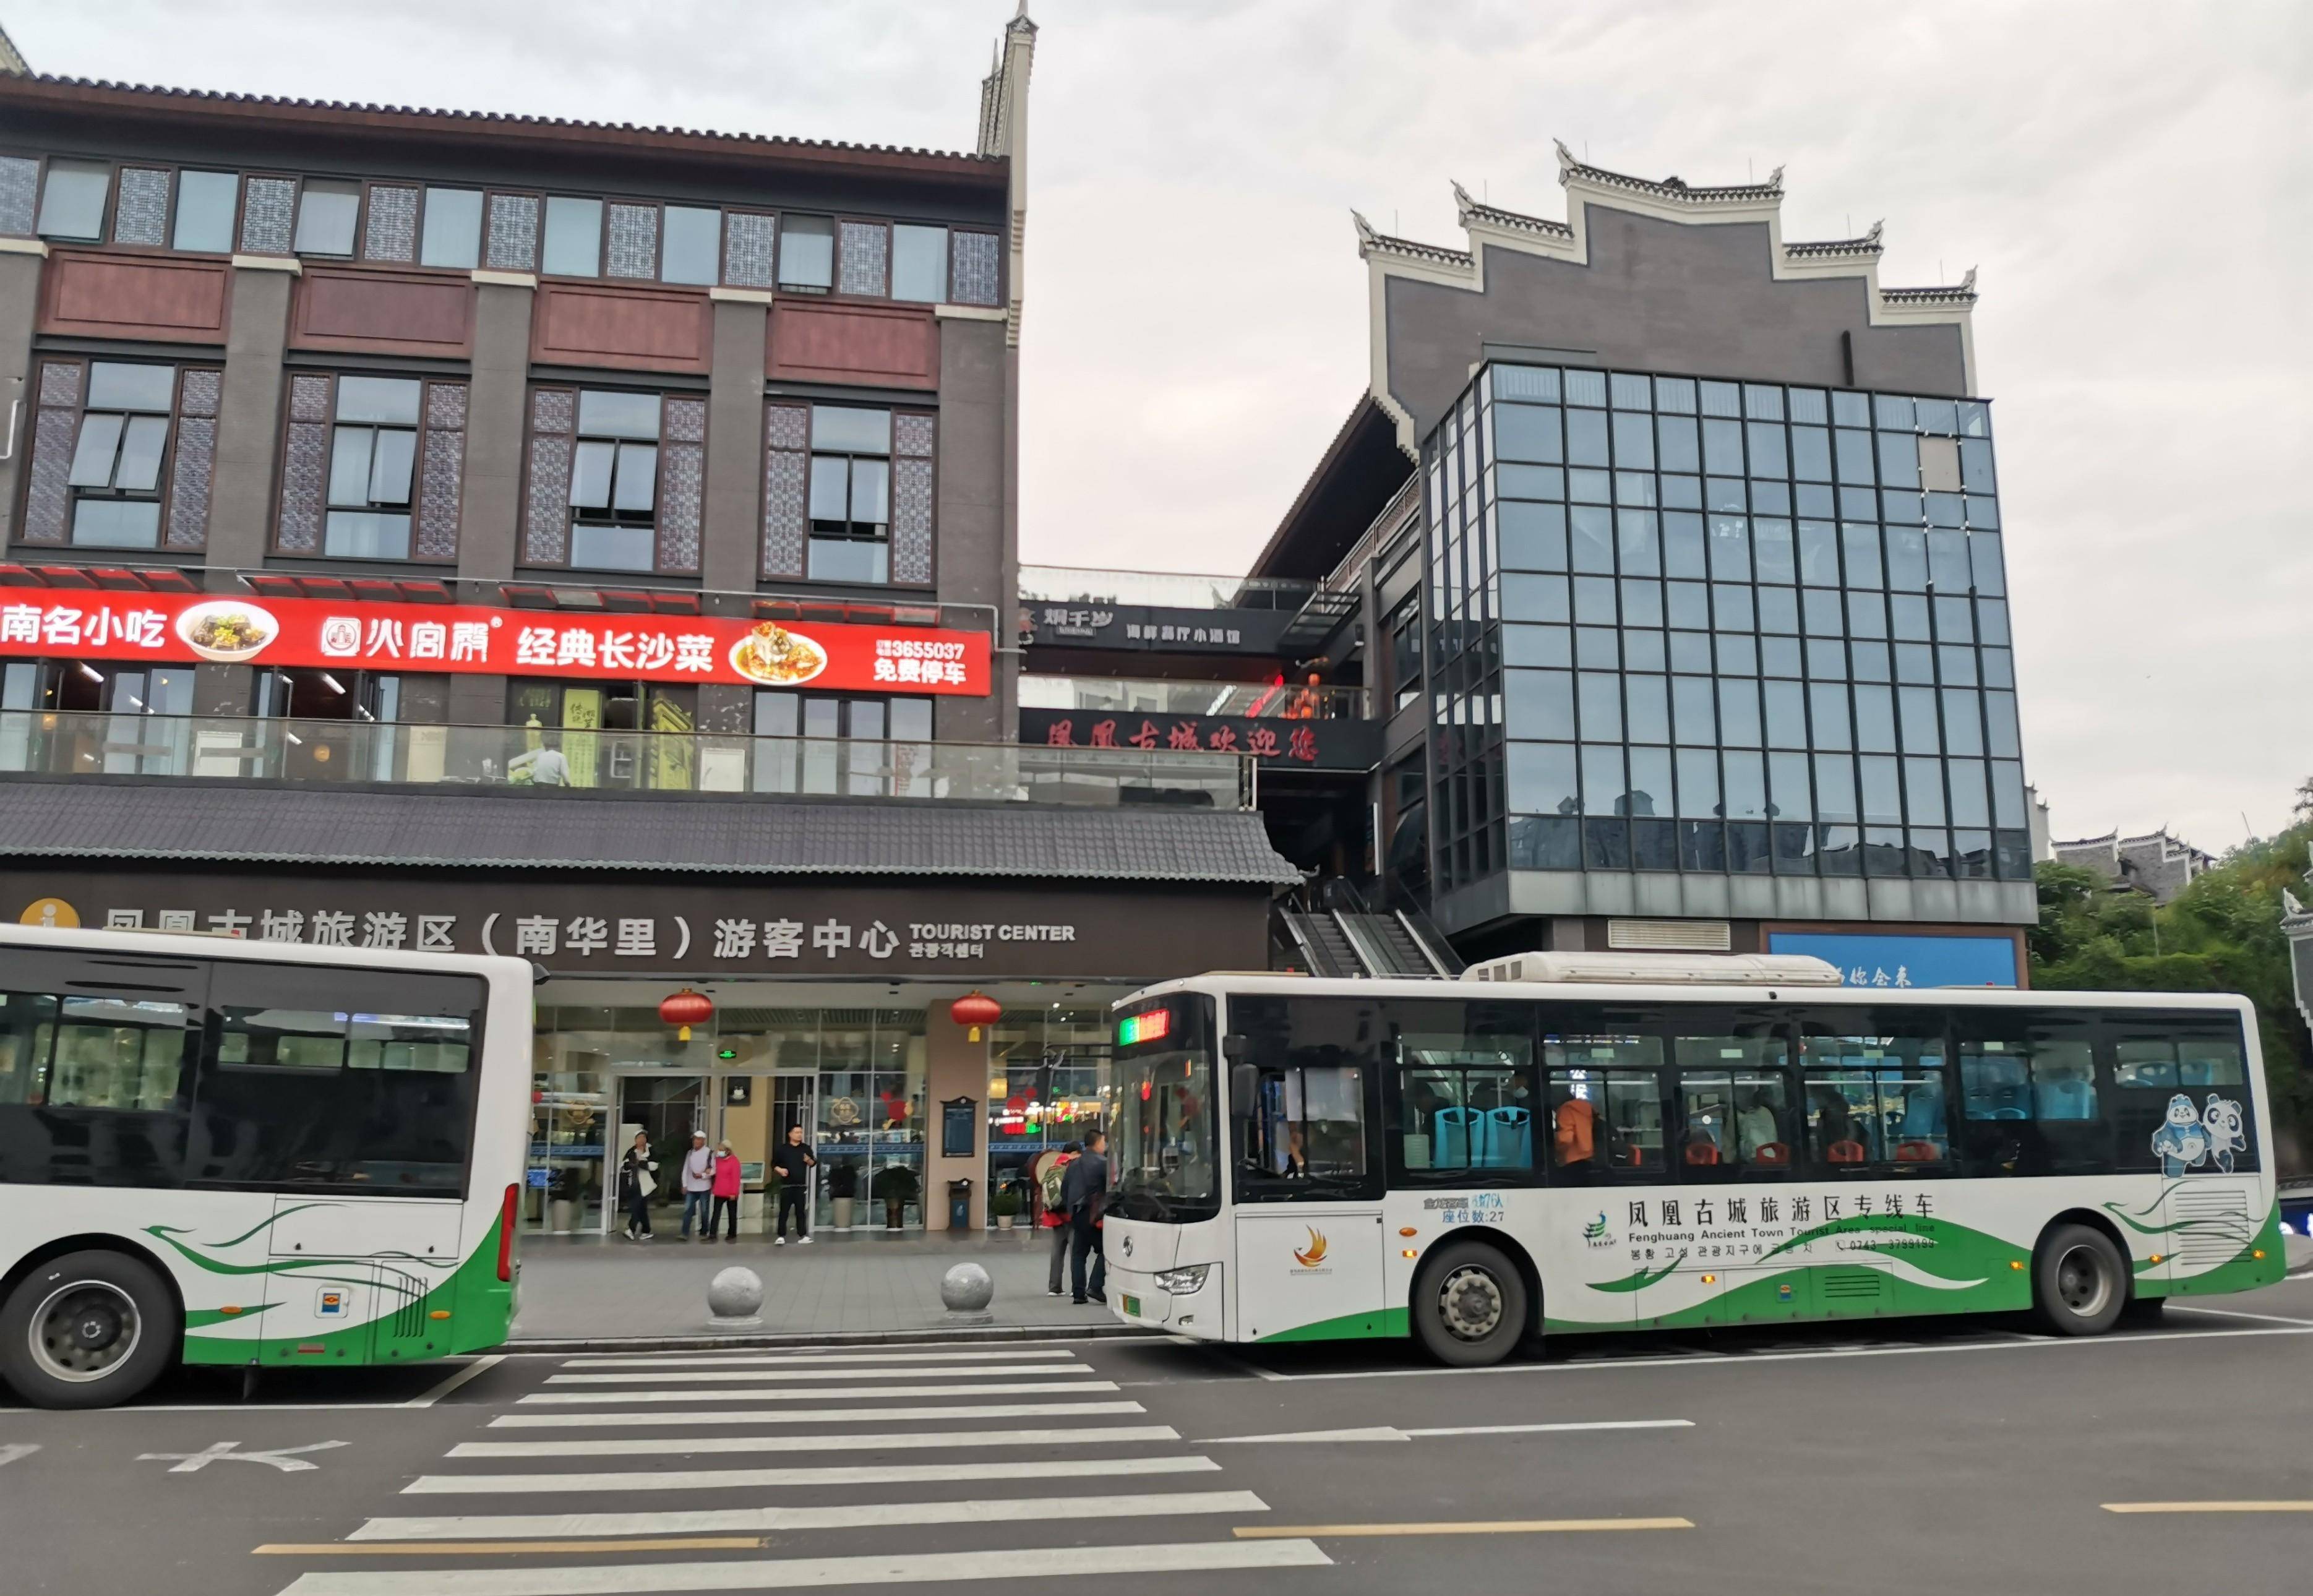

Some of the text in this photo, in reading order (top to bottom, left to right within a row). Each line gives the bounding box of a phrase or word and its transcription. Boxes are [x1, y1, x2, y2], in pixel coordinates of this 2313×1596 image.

[1, 603, 168, 648] 南名小吃
[366, 618, 489, 663] 火宫殿
[516, 625, 714, 673] 经典长沙菜
[873, 657, 967, 685] 免费停车
[1047, 718, 1320, 762] 凤凰古城欢迎您
[909, 924, 1076, 941] TOURIST CENTER
[909, 942, 984, 959] 관광객센터
[1837, 964, 1912, 988] 你会来
[1629, 1193, 1934, 1227] 凤凰古城旅游区专线车
[1629, 1232, 1694, 1243] Fenghuang
[1701, 1229, 1745, 1239] Ancient
[1751, 1228, 1783, 1238] Town
[1790, 1227, 1829, 1237] Tourist
[1836, 1225, 1860, 1234] Area
[1869, 1224, 1907, 1235] special
[1915, 1223, 1935, 1232] line
[1850, 1239, 1877, 1250] 0743
[1631, 1248, 1655, 1260] 봉황
[1665, 1246, 1688, 1258] 고성
[1698, 1244, 1762, 1257] 관광지구에
